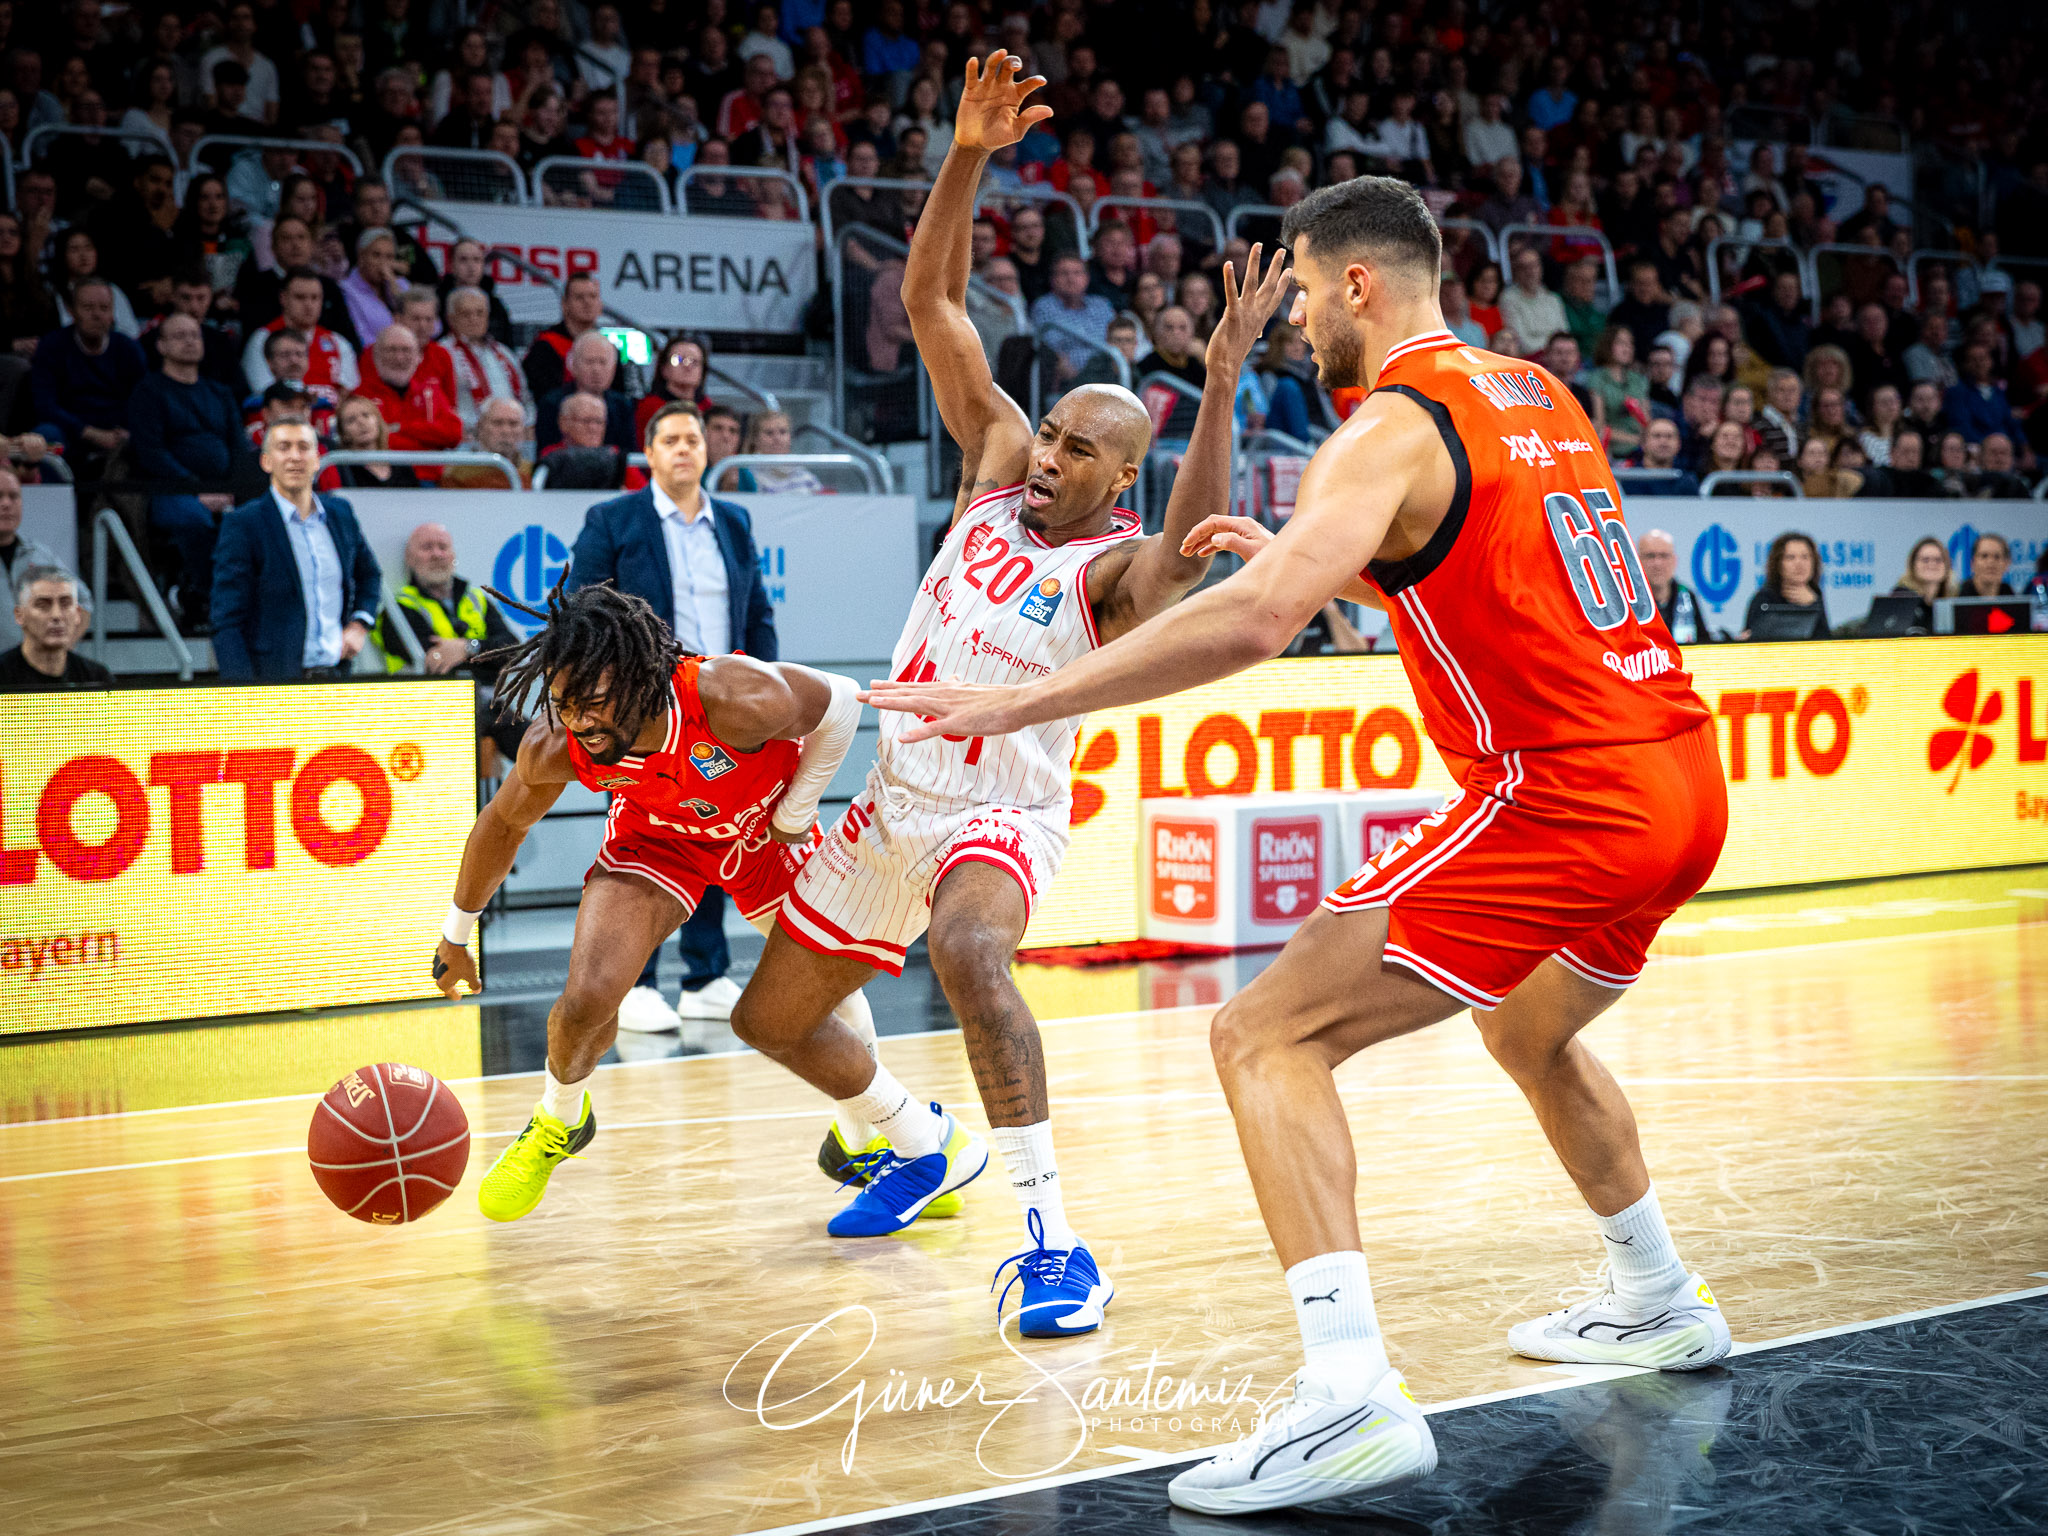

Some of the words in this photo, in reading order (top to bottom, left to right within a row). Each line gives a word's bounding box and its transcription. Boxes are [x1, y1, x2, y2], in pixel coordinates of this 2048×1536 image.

[614, 251, 790, 295] ARENA
[1500, 429, 1552, 467] xpd
[963, 537, 1034, 605] 20
[1544, 488, 1656, 631] 65
[1022, 604, 1047, 623] BBL
[706, 763, 732, 778] BBL
[1138, 707, 1421, 800] LOTTO
